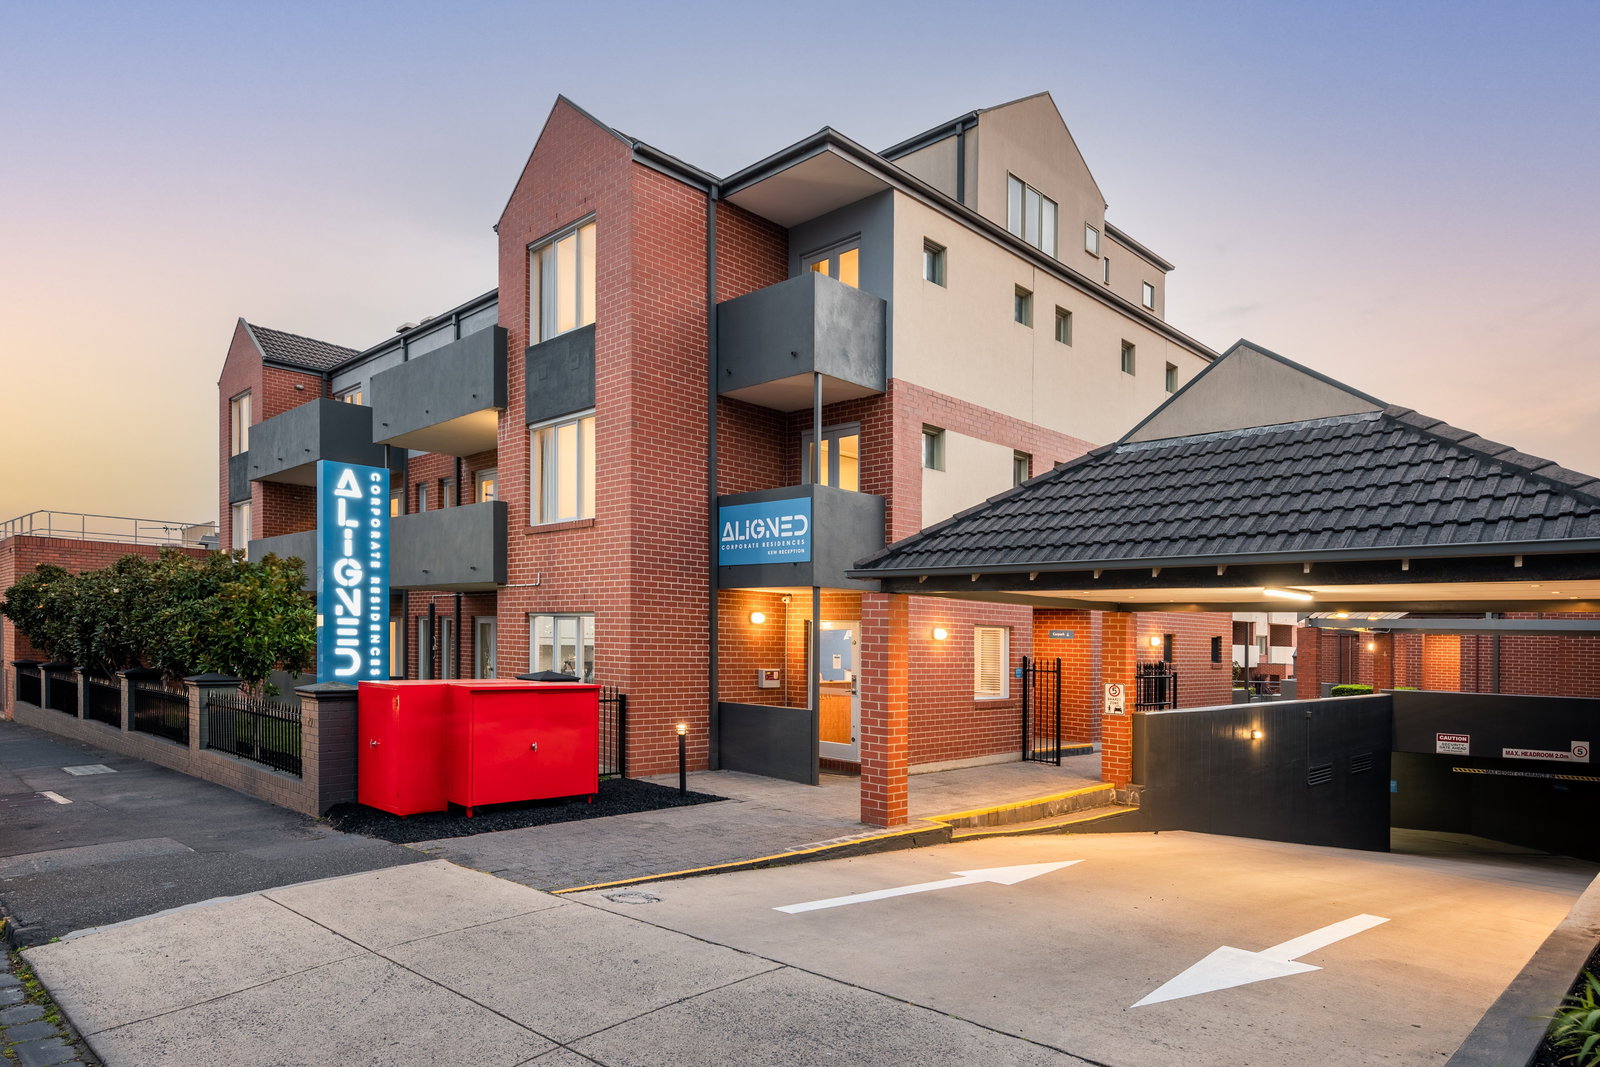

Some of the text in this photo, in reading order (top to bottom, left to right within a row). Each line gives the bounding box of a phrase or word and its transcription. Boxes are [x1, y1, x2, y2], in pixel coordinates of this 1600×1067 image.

[333, 469, 363, 676] ALIGNED
[370, 472, 381, 676] CORPORATE RESIDENCES
[721, 514, 808, 542] ALIGNED
[721, 539, 805, 550] CORPORATE RESIDENCES
